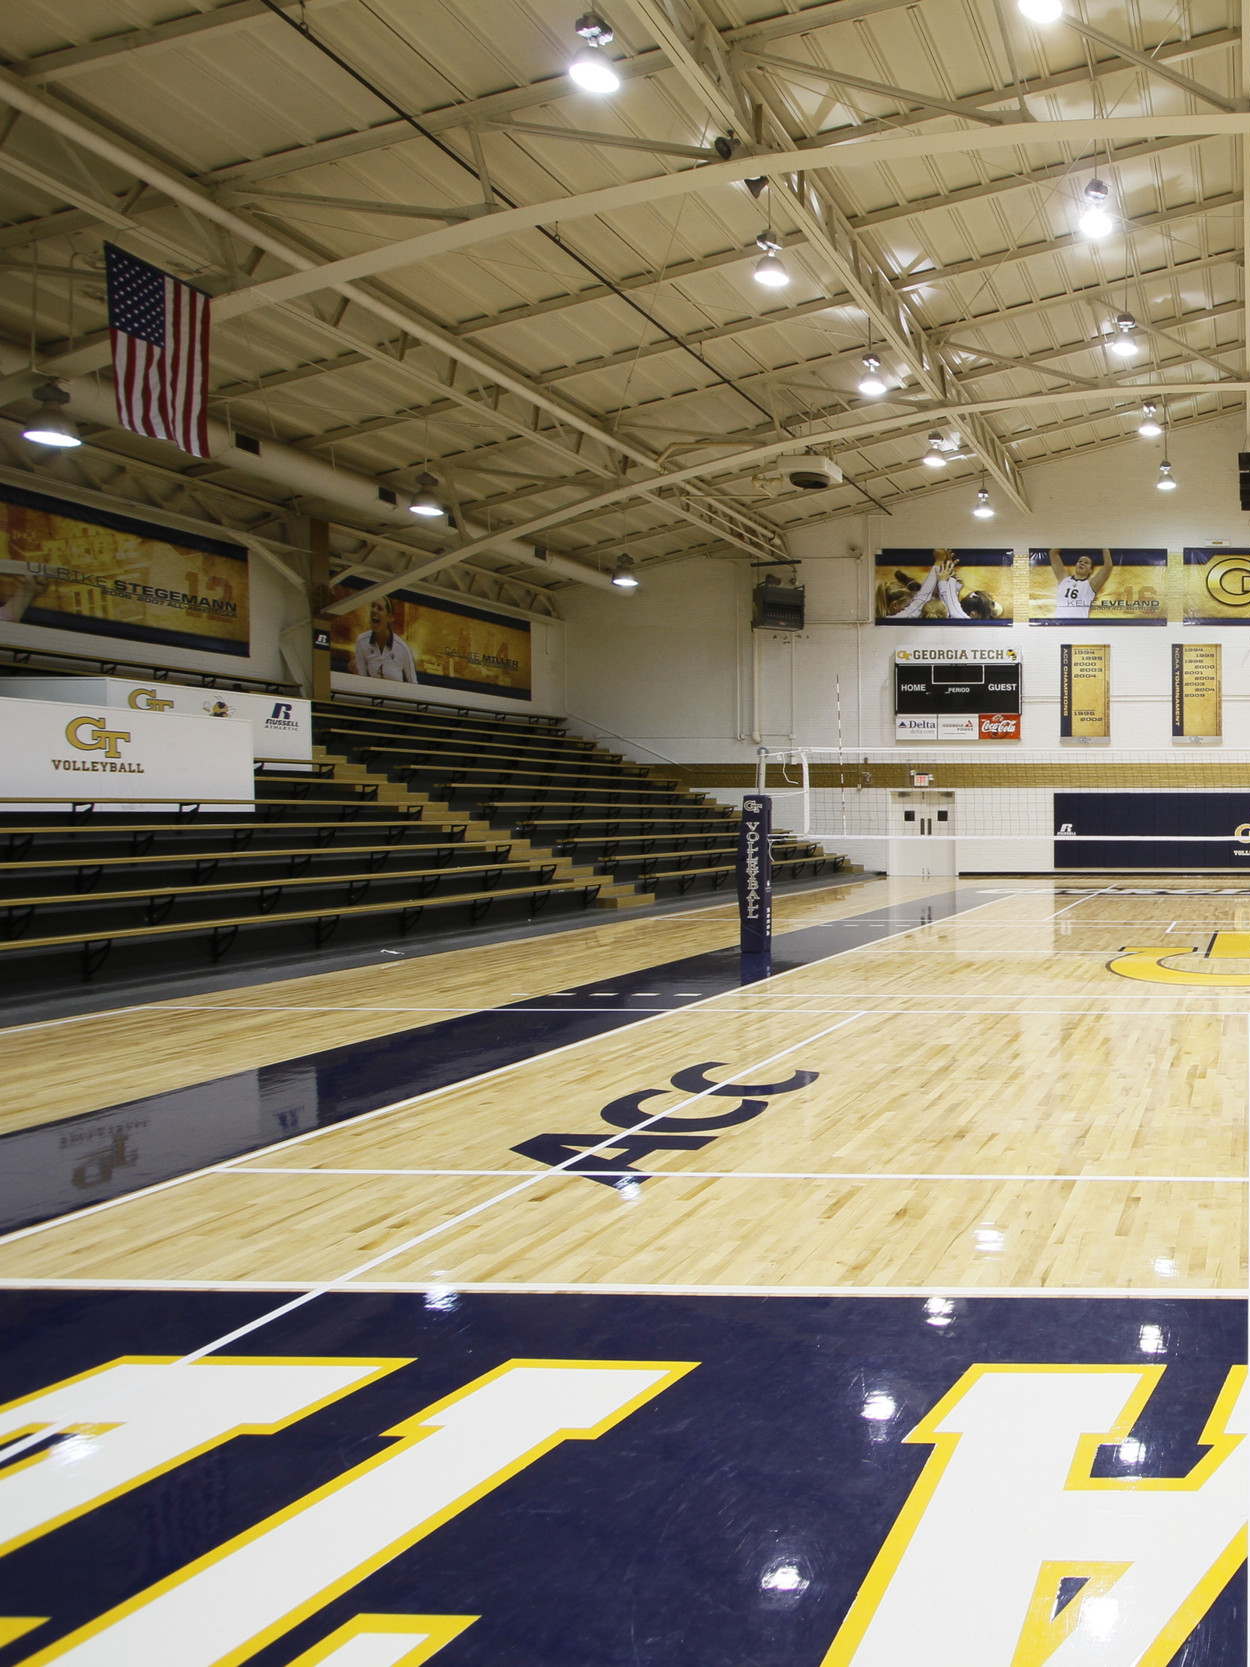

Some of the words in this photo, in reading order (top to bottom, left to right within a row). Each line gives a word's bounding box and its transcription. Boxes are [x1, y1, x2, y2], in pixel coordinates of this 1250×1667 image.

[26, 561, 108, 588] ULRIKE
[113, 579, 238, 612] STEGEMANN
[1064, 587, 1079, 600] 16
[913, 649, 969, 660] GEORGIA
[971, 649, 1004, 660] TECH
[901, 684, 926, 692] HOME
[988, 683, 1017, 691] GUEST
[265, 718, 300, 728] RUSSELL
[909, 720, 936, 729] Delta
[65, 715, 131, 758] GT
[51, 758, 145, 774] VOLLEYBALL
[745, 821, 760, 919] VOLLEYBALL
[508, 1061, 820, 1192] ACC
